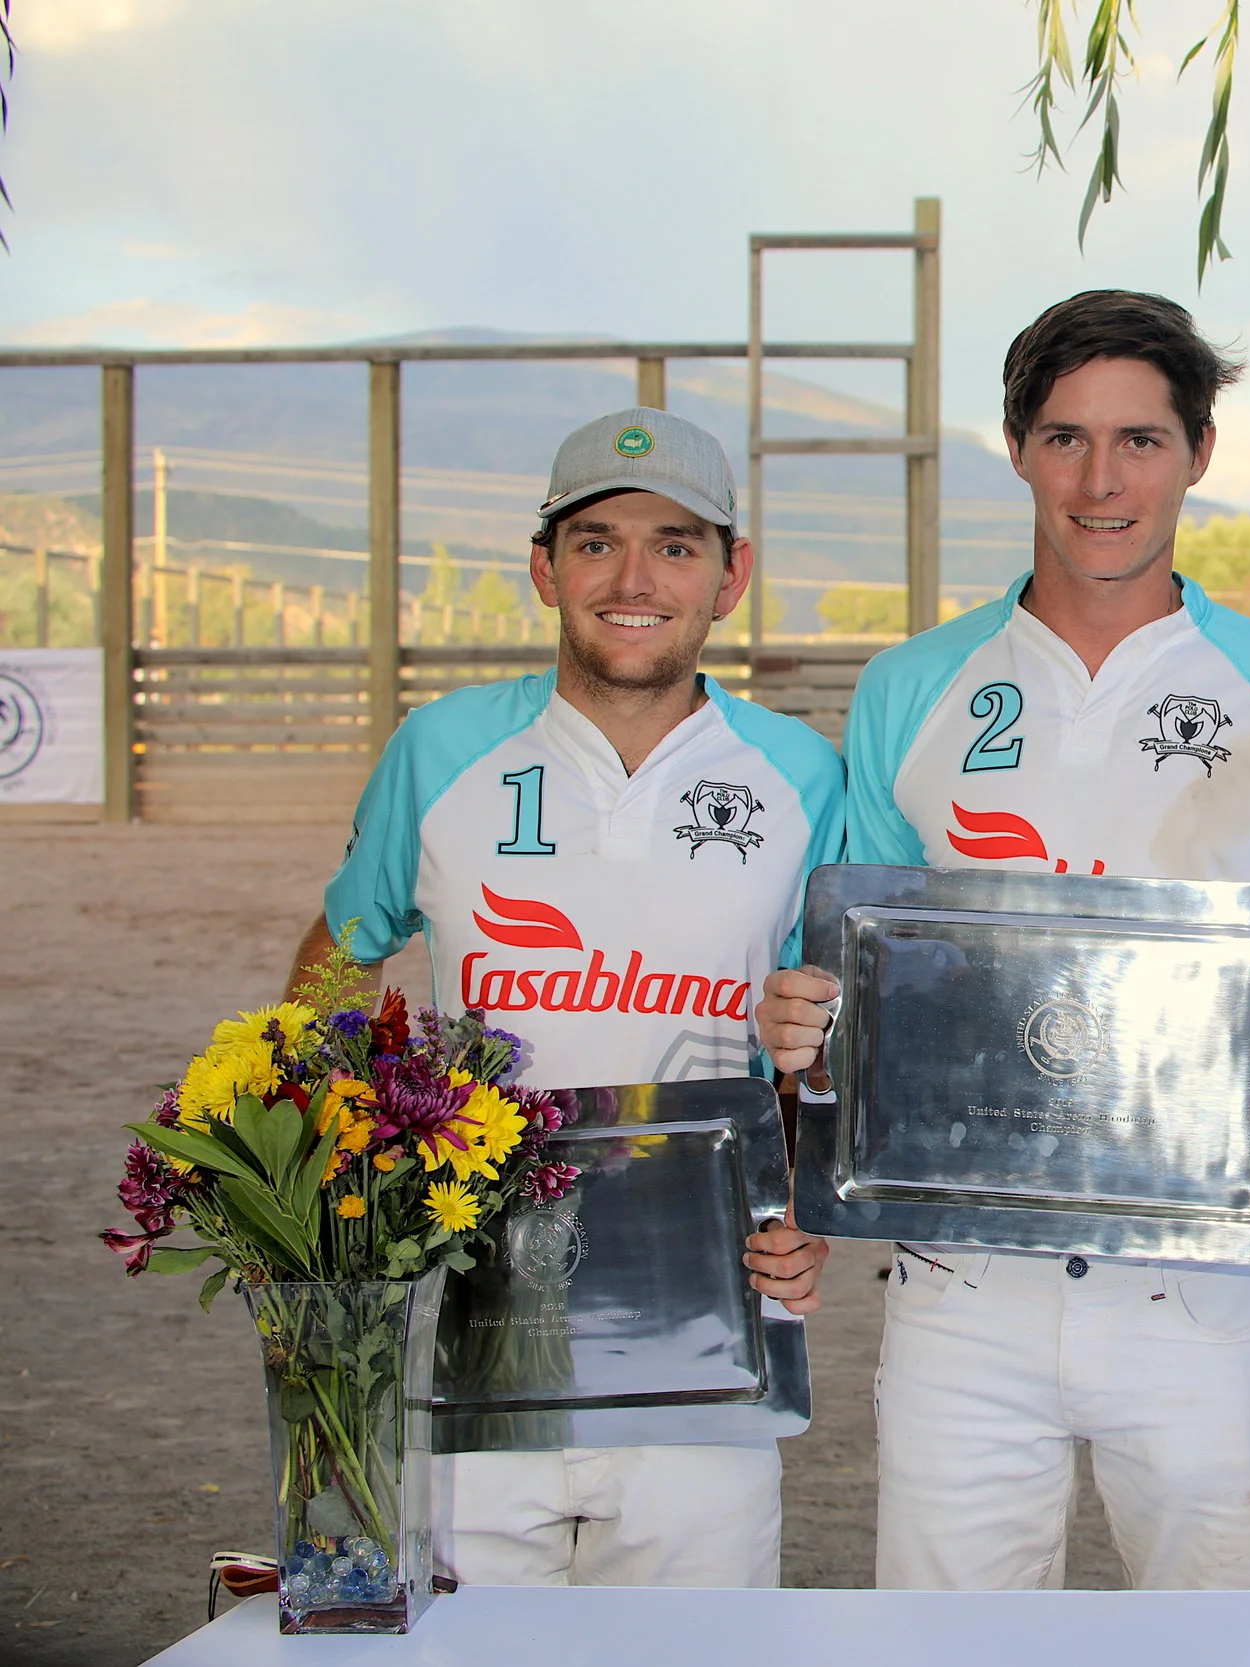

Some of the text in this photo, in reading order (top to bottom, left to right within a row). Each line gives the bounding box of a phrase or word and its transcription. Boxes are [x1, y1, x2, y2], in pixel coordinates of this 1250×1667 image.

[959, 680, 1026, 776] 2
[1179, 744, 1212, 756] Champions
[496, 763, 558, 857] 1
[967, 1105, 1008, 1118] United
